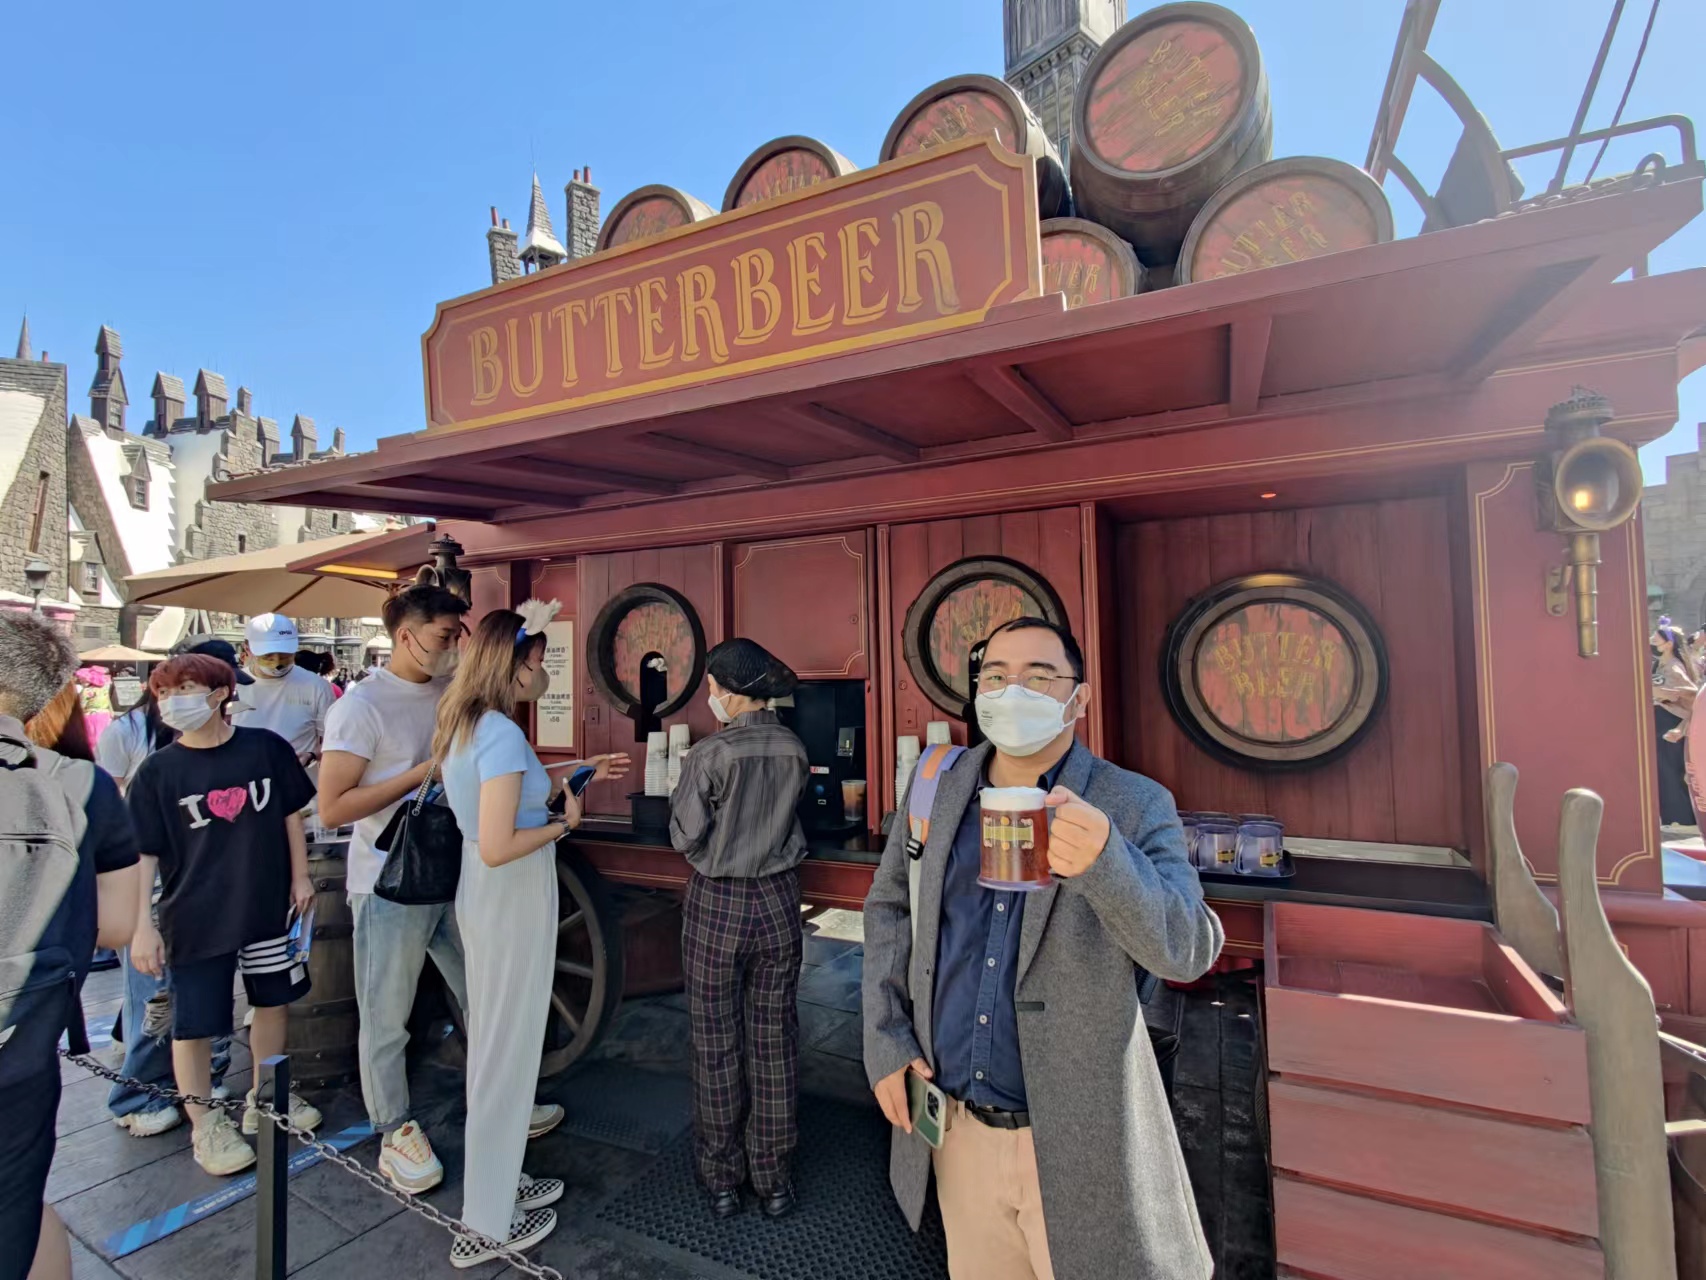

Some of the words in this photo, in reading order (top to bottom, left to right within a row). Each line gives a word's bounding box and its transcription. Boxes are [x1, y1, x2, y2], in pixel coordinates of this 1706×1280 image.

[467, 200, 961, 407] BUTTERBEER
[1214, 631, 1336, 673] BUTTER
[178, 794, 212, 829] I
[248, 777, 271, 812] U
